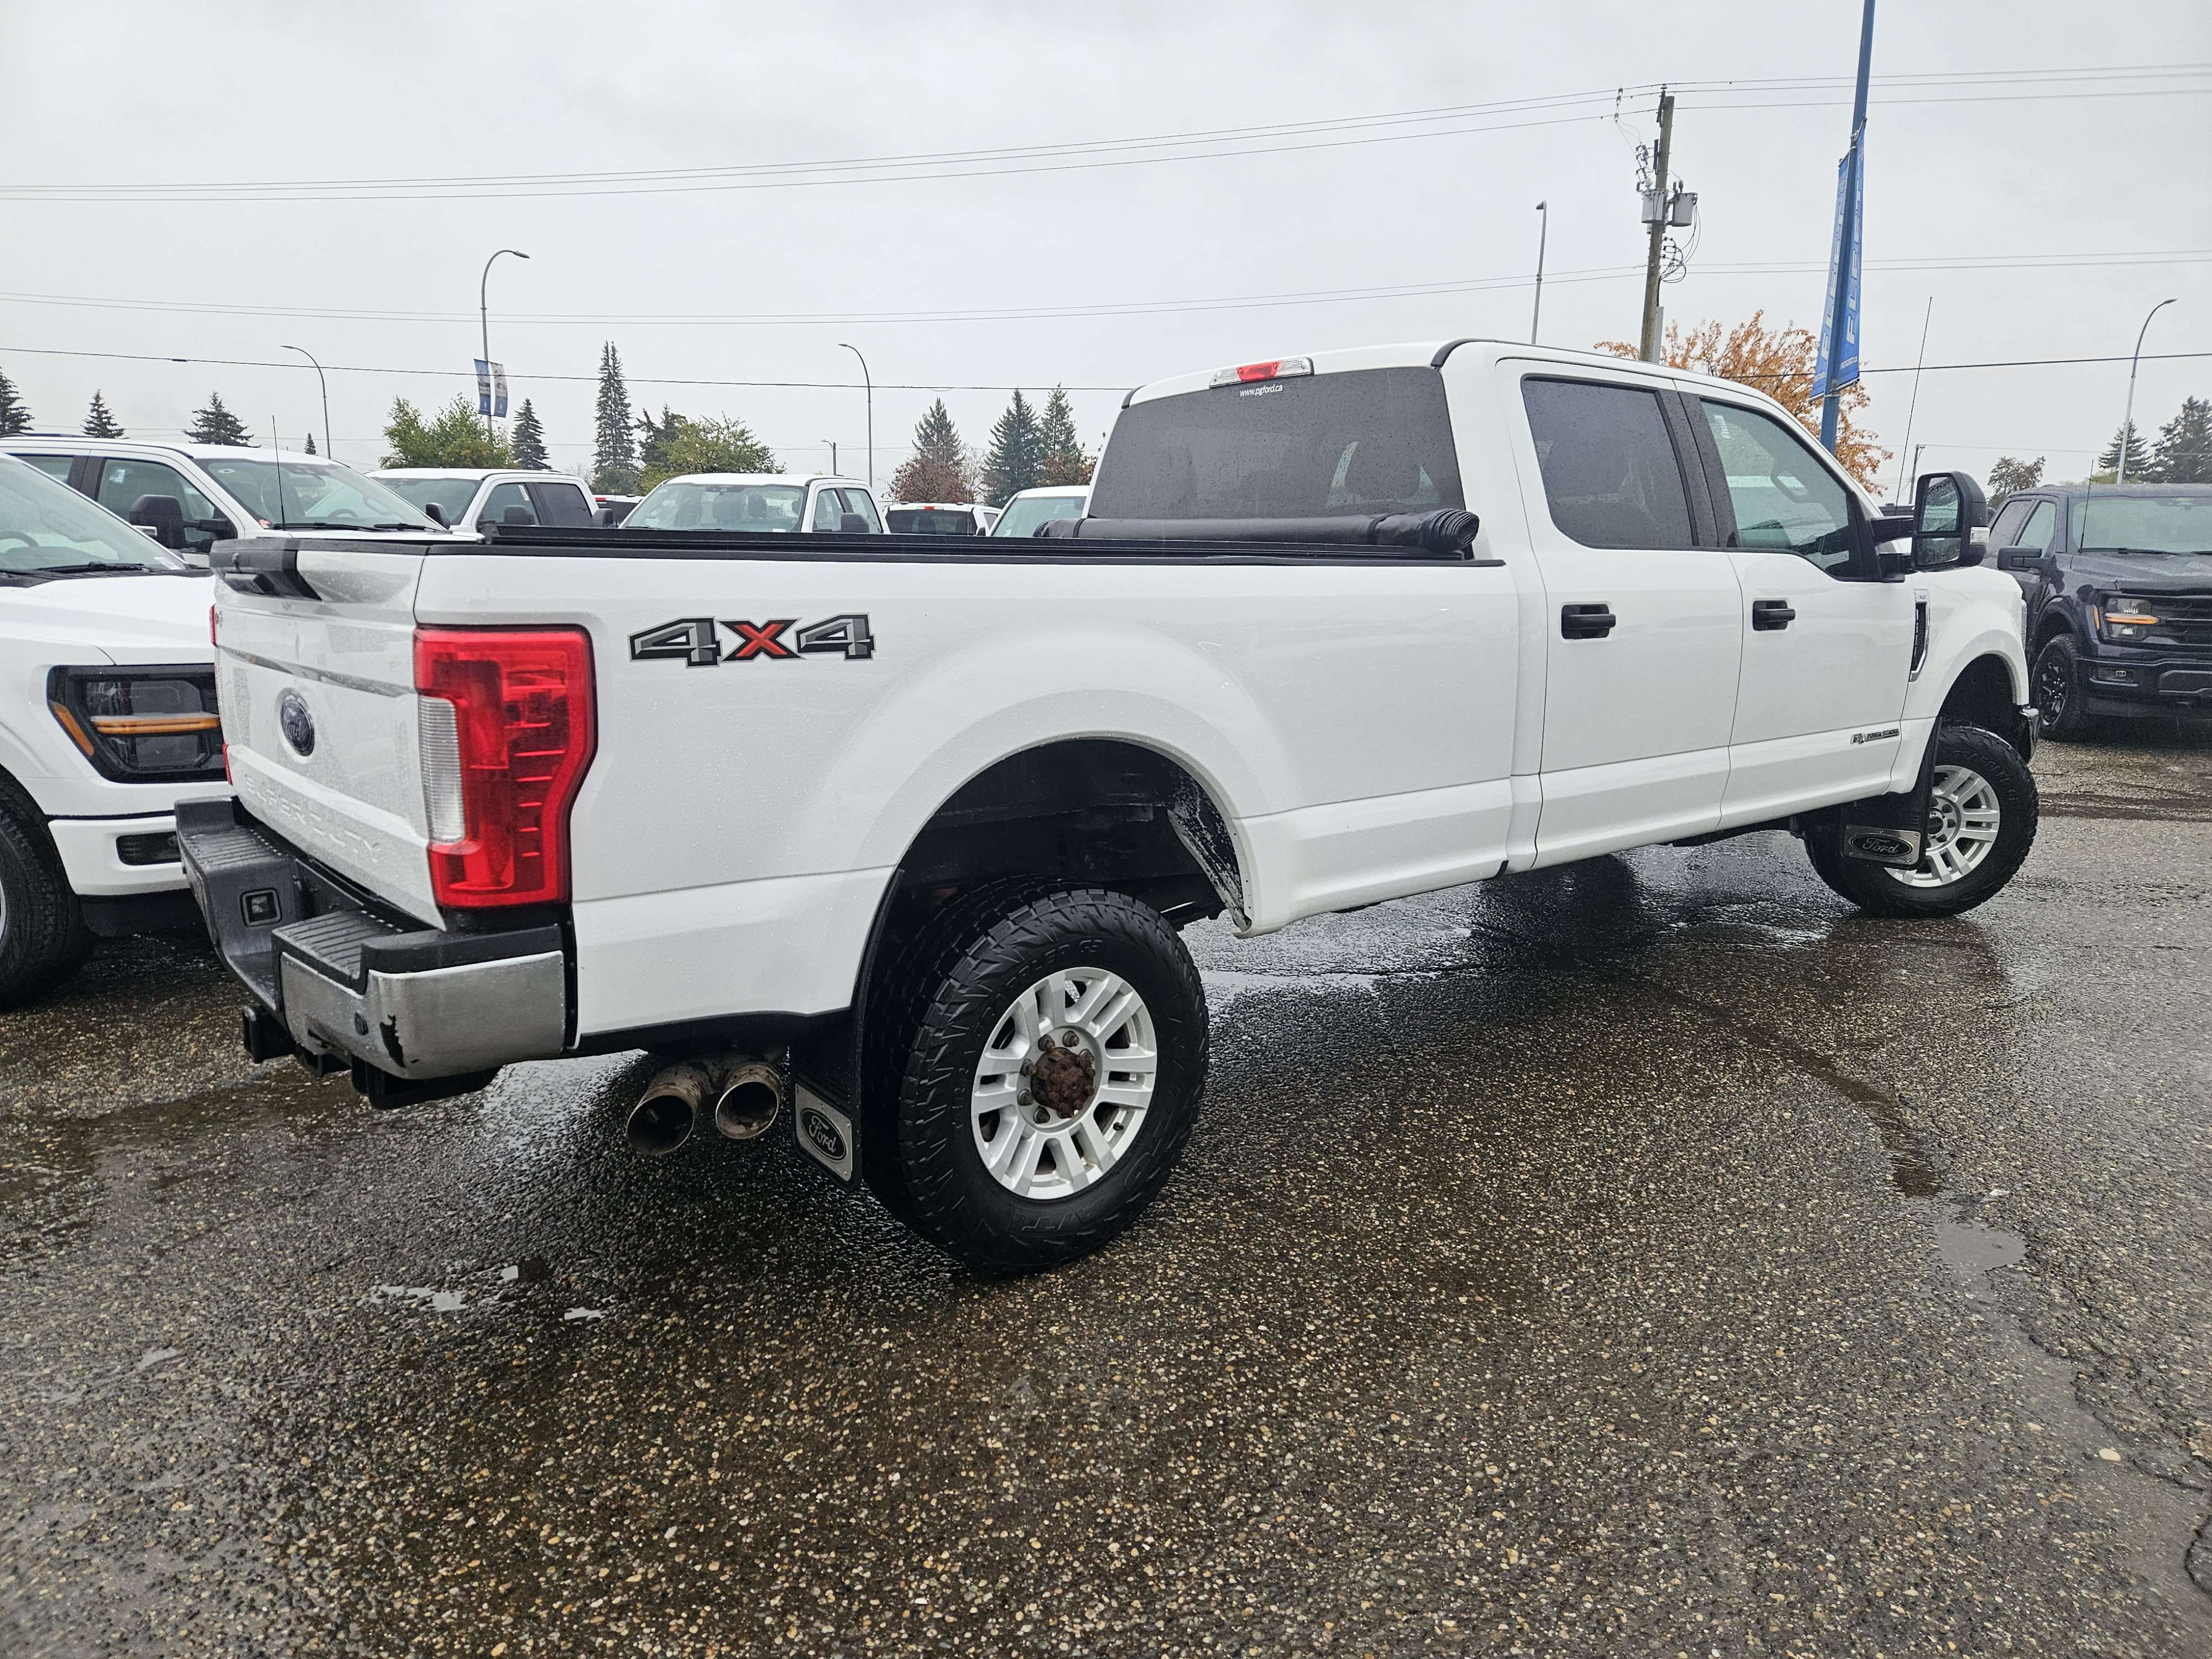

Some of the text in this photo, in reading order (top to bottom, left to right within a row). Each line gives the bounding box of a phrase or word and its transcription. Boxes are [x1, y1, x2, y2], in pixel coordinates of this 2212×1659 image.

[1240, 384, 1283, 397] www.pgford.ca
[1863, 837, 1900, 854] Ford
[809, 1115, 837, 1154] Ford
